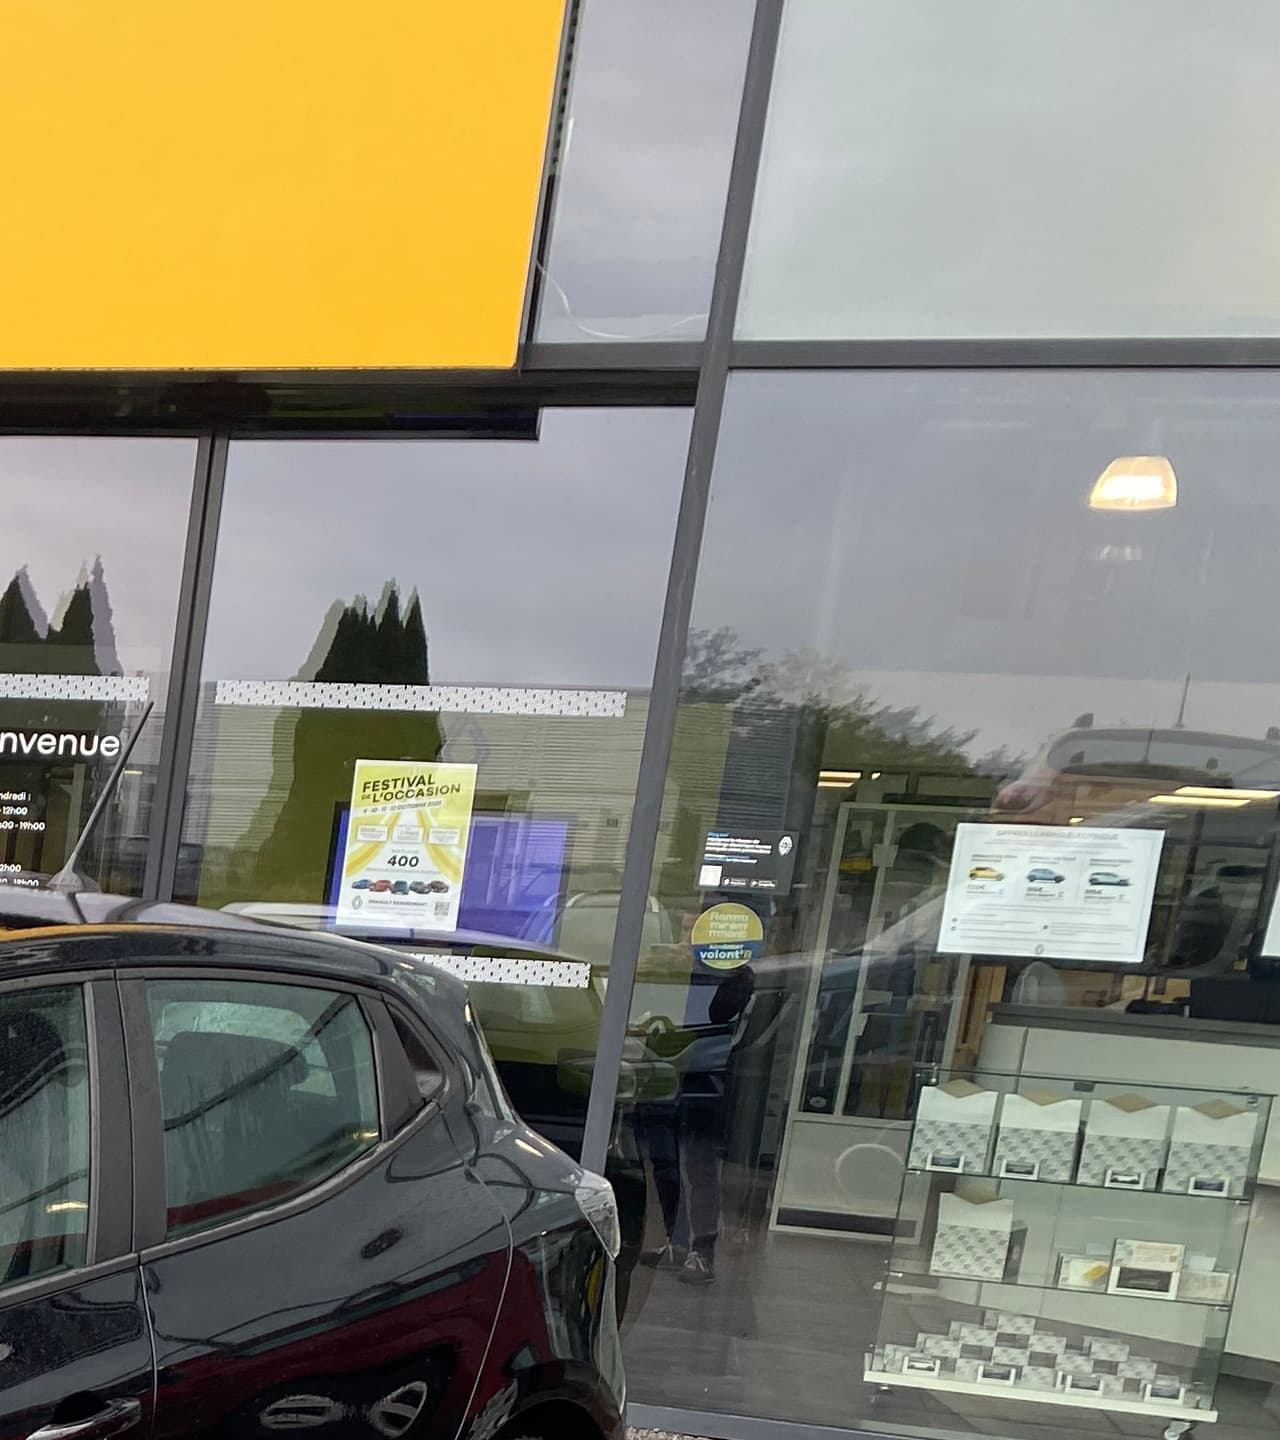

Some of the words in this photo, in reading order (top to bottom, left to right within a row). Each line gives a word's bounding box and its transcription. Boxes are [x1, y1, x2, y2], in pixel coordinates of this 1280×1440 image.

[362, 774, 436, 793] FESTIVAL
[372, 784, 461, 803] L'OCCASION
[2, 806, 28, 815] 12h00
[19, 821, 45, 831] 19h00
[387, 855, 419, 867] 400
